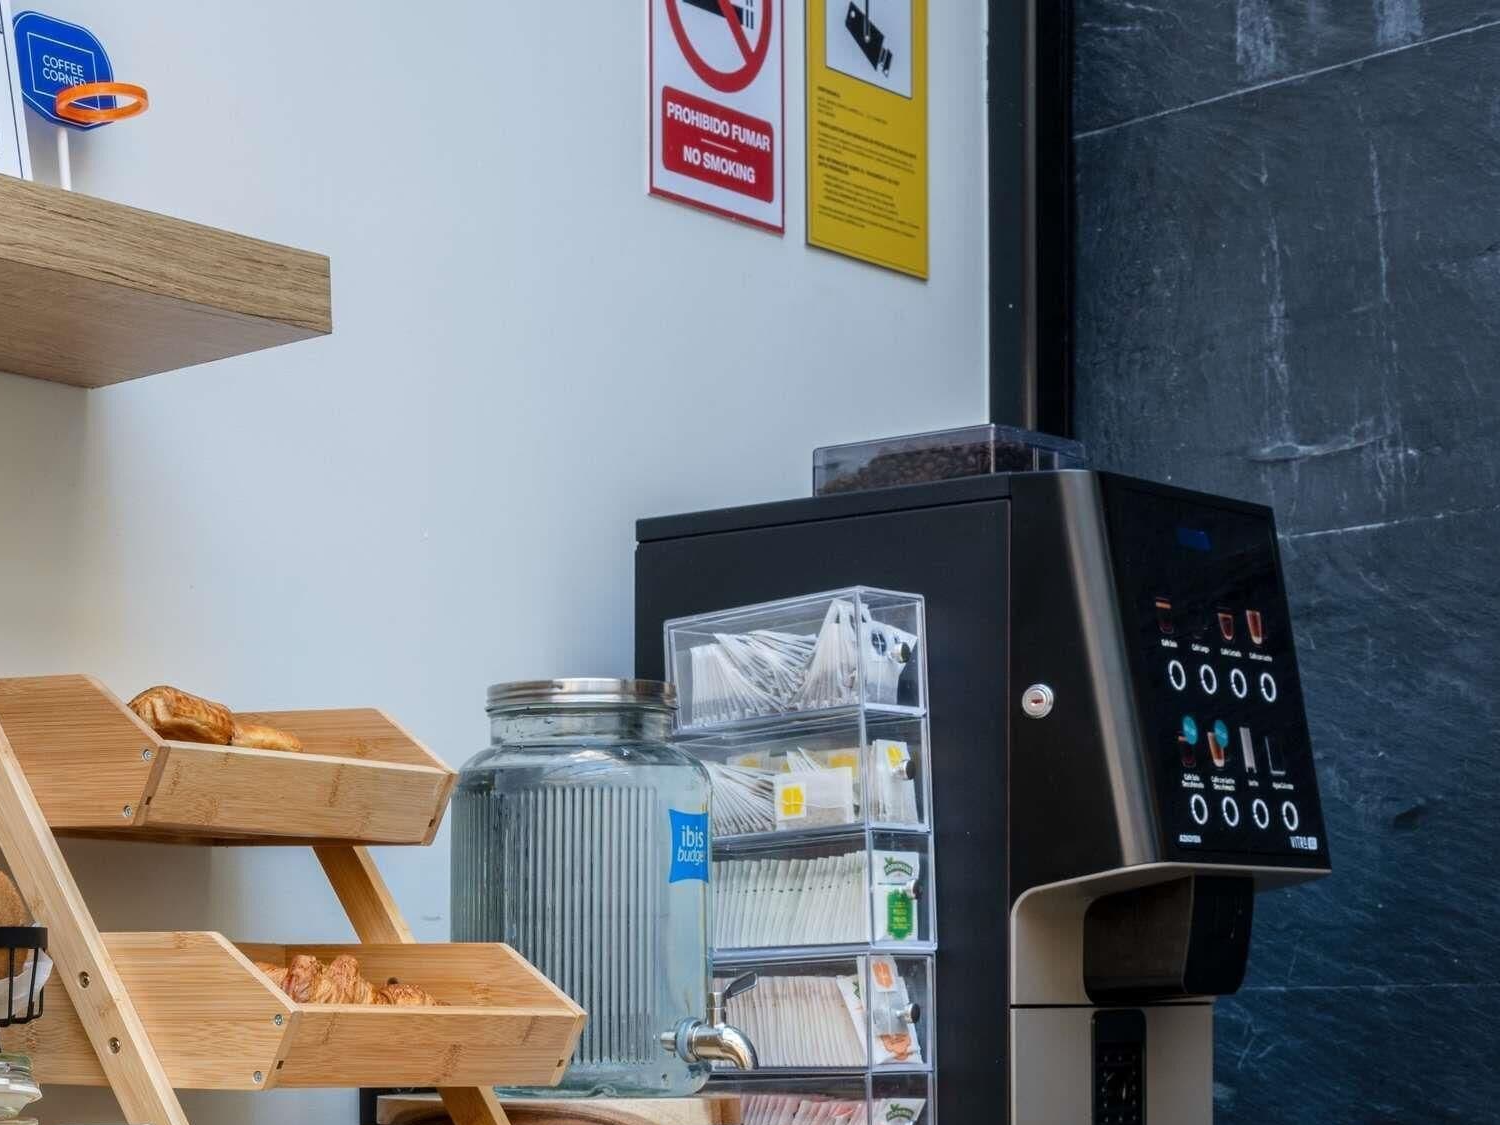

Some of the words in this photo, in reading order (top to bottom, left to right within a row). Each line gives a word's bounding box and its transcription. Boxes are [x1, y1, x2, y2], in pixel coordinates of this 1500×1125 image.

[42, 54, 85, 77] COFFEE
[666, 101, 730, 137] PROHIBIDO
[731, 124, 771, 152] FUMAR
[683, 145, 701, 165] NO
[702, 151, 756, 184] SMOKING
[682, 825, 704, 848] ibis
